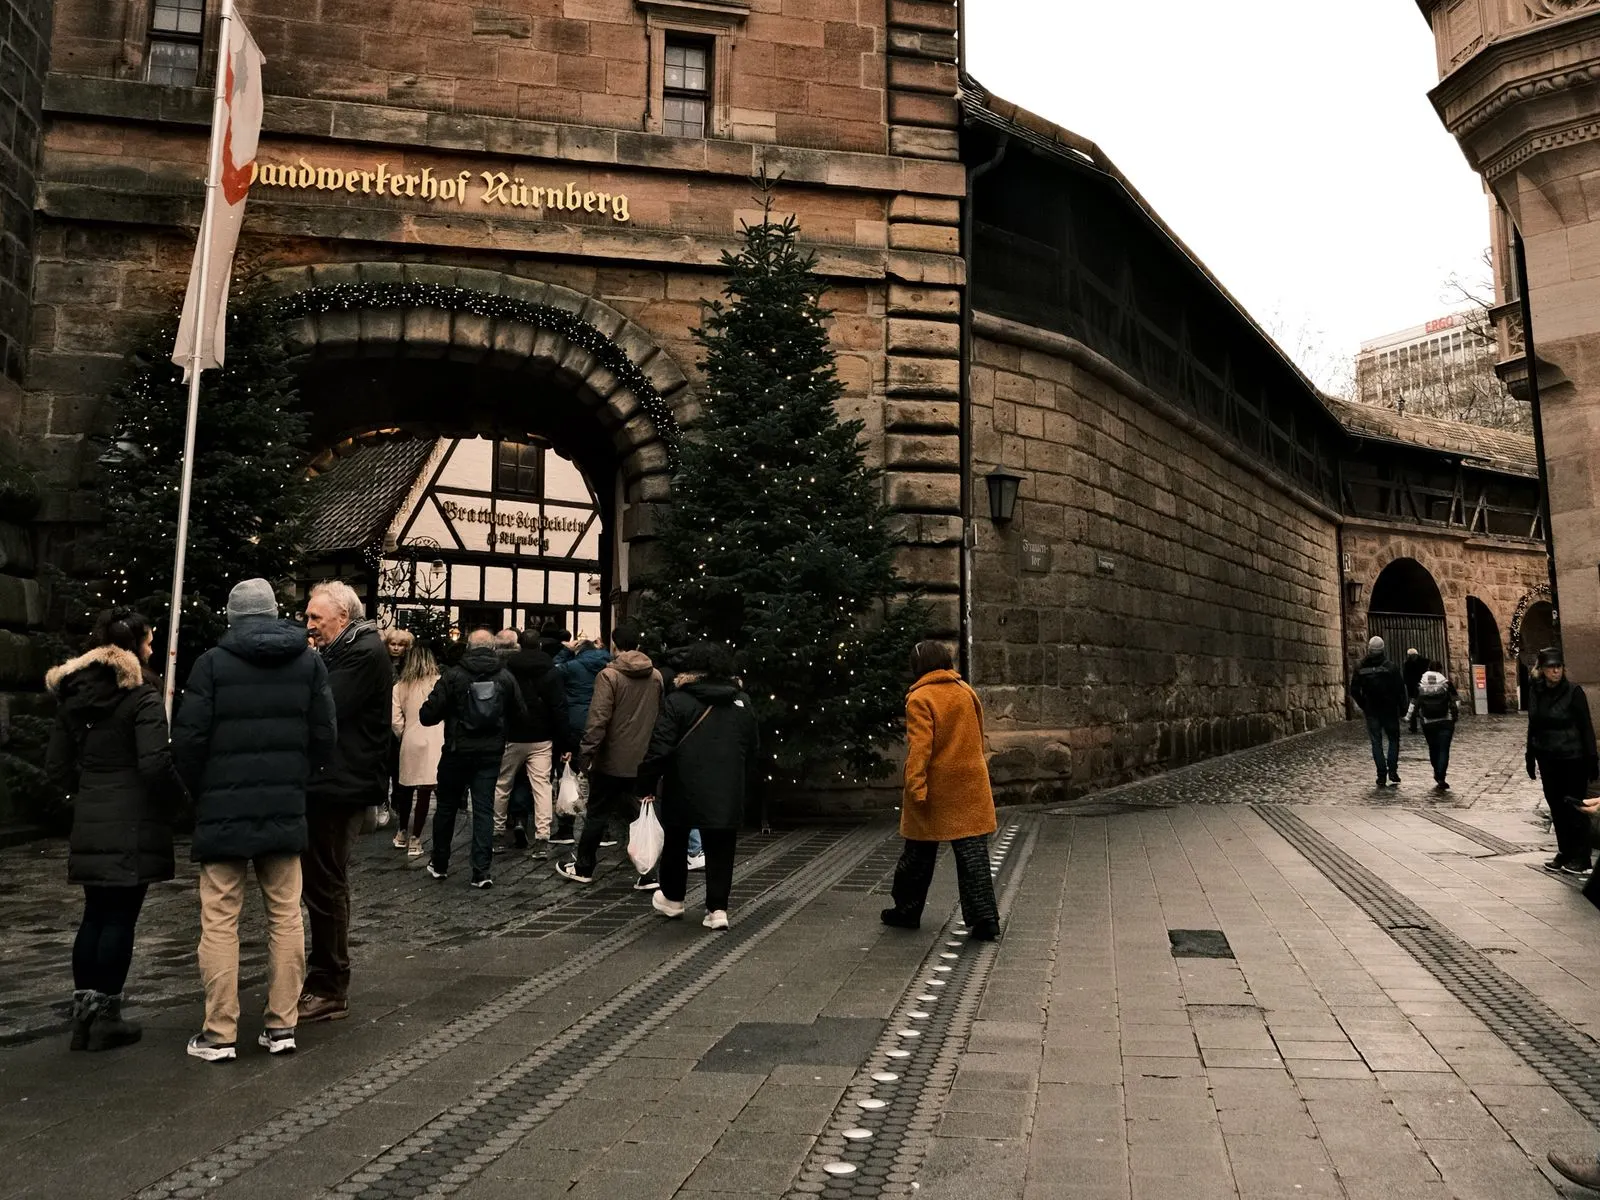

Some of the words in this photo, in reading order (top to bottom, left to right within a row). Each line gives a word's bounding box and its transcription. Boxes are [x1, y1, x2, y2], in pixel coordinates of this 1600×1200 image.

[250, 157, 472, 205] andwerkerhof
[480, 170, 630, 221] Nürnberg
[1425, 315, 1453, 334] ERGO
